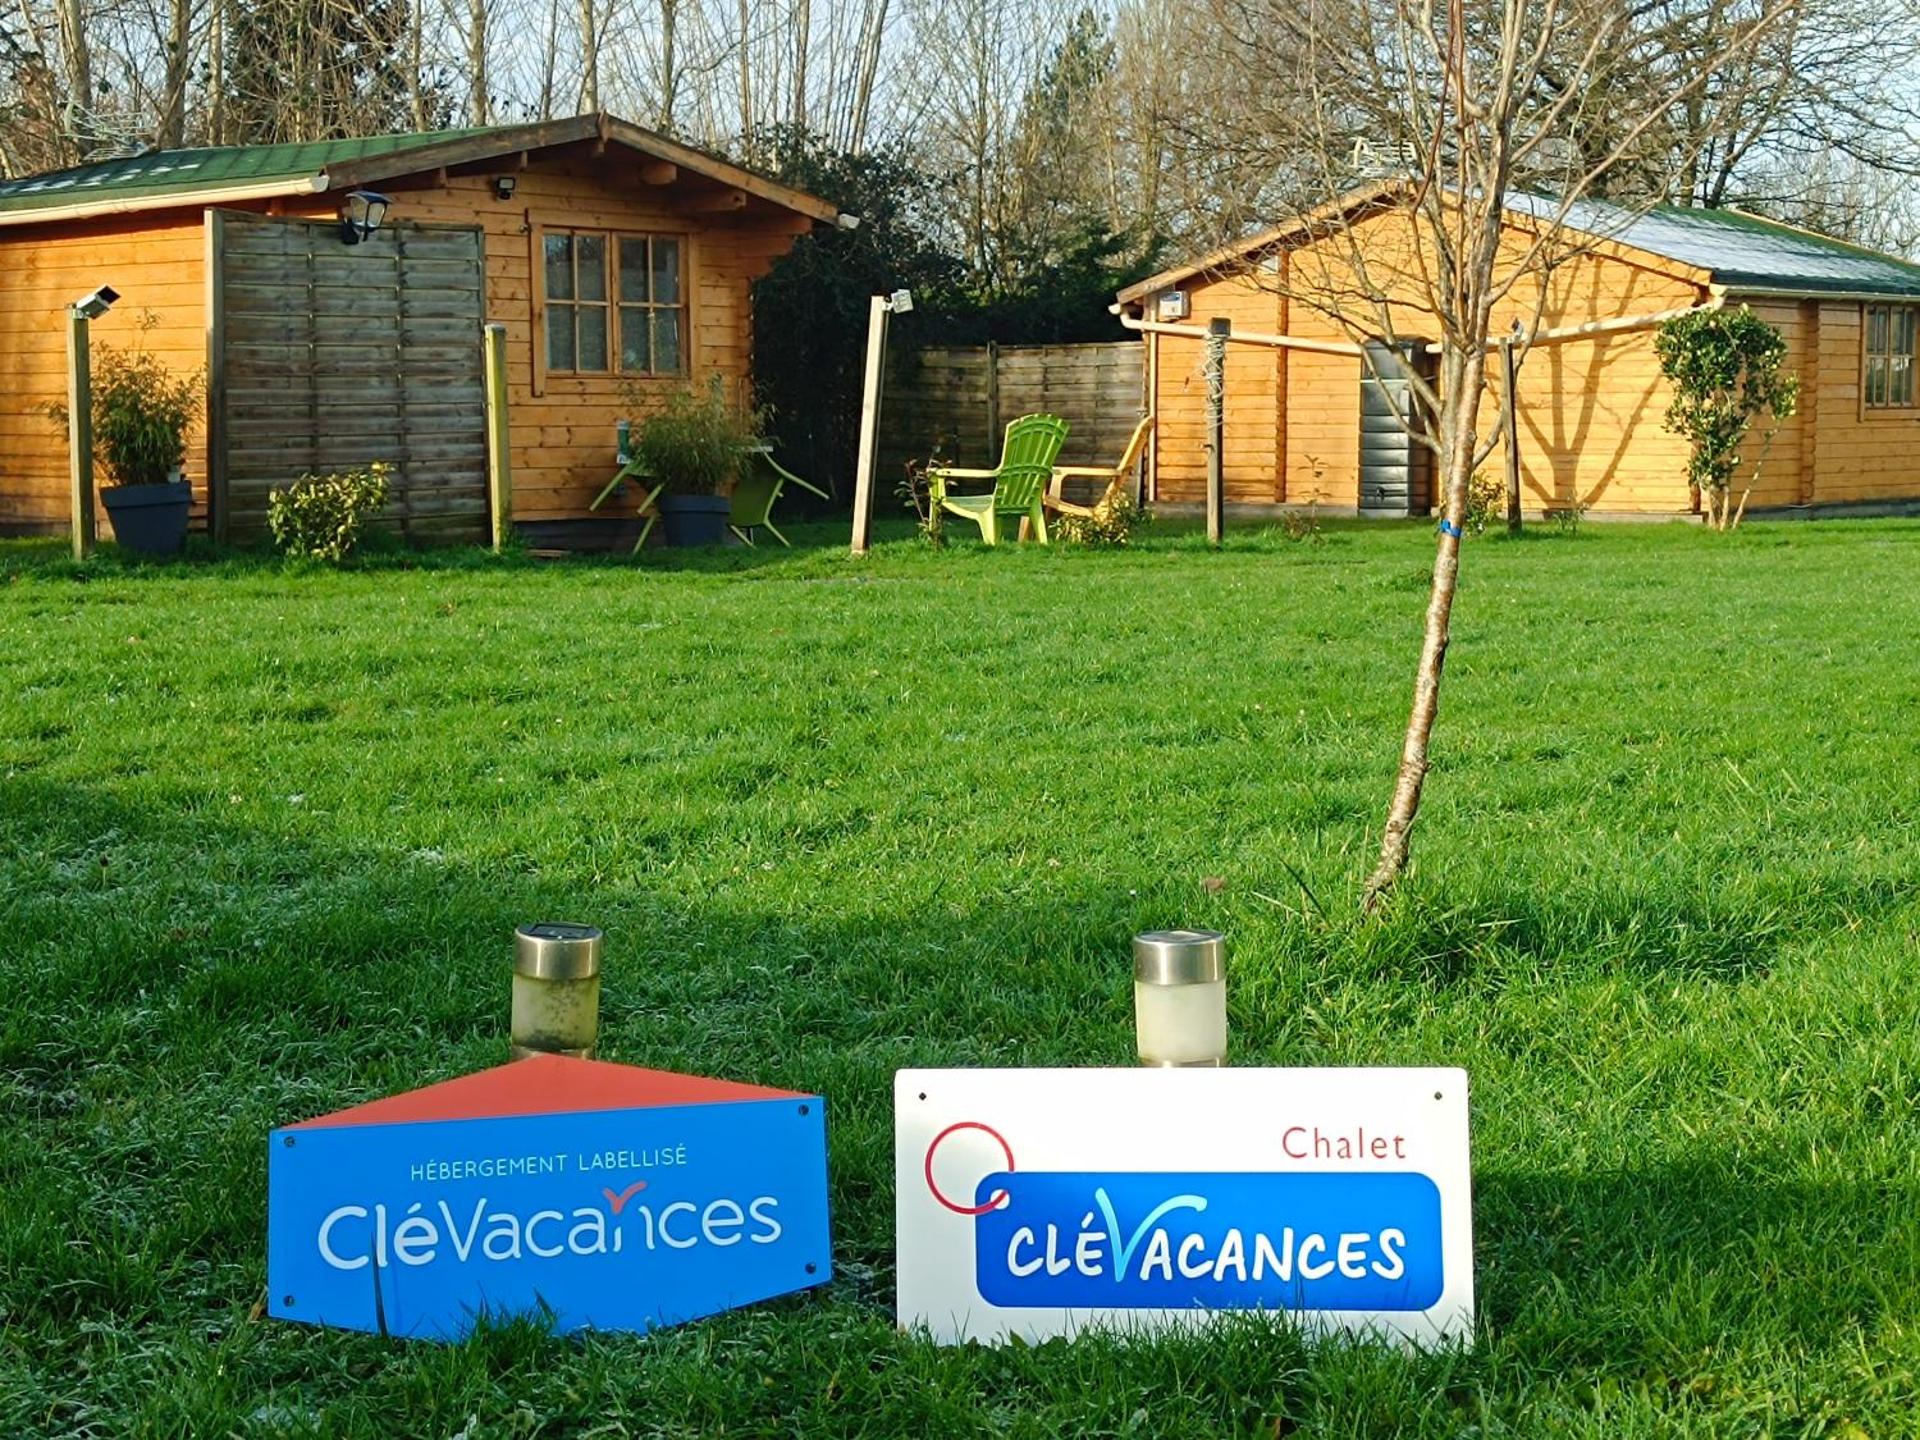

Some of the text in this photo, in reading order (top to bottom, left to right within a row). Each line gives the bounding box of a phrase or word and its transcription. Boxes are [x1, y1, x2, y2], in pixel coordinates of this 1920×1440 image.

[410, 1143, 688, 1182] HÉBERGEMENT LABELLISÉ
[1282, 1126, 1406, 1159] Chalet
[317, 1181, 783, 1270] CléVacances
[1007, 1187, 1407, 1282] CLÉVACANCES
